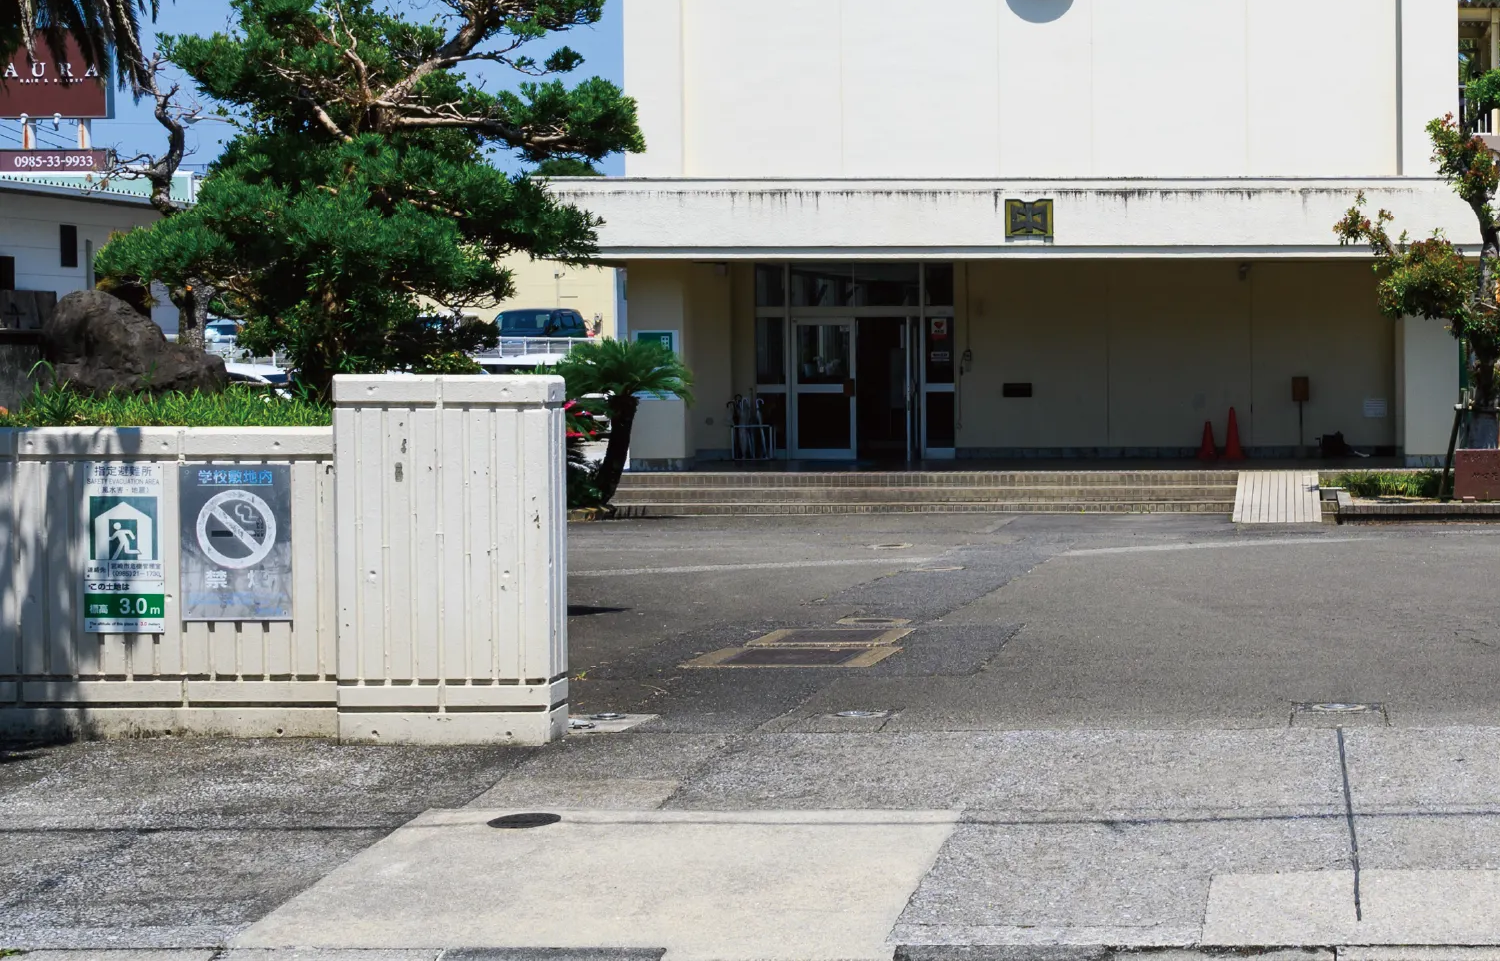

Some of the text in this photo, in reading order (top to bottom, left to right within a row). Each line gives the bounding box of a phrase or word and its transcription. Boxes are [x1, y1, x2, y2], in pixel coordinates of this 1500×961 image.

[3, 62, 100, 78] AURA
[14, 155, 94, 168] 0985-33-9933
[94, 465, 153, 478] 指定避難所
[198, 469, 273, 484] 学校敷地内
[90, 583, 130, 591] この土地は
[119, 597, 148, 615] 3.0
[150, 607, 161, 615] m
